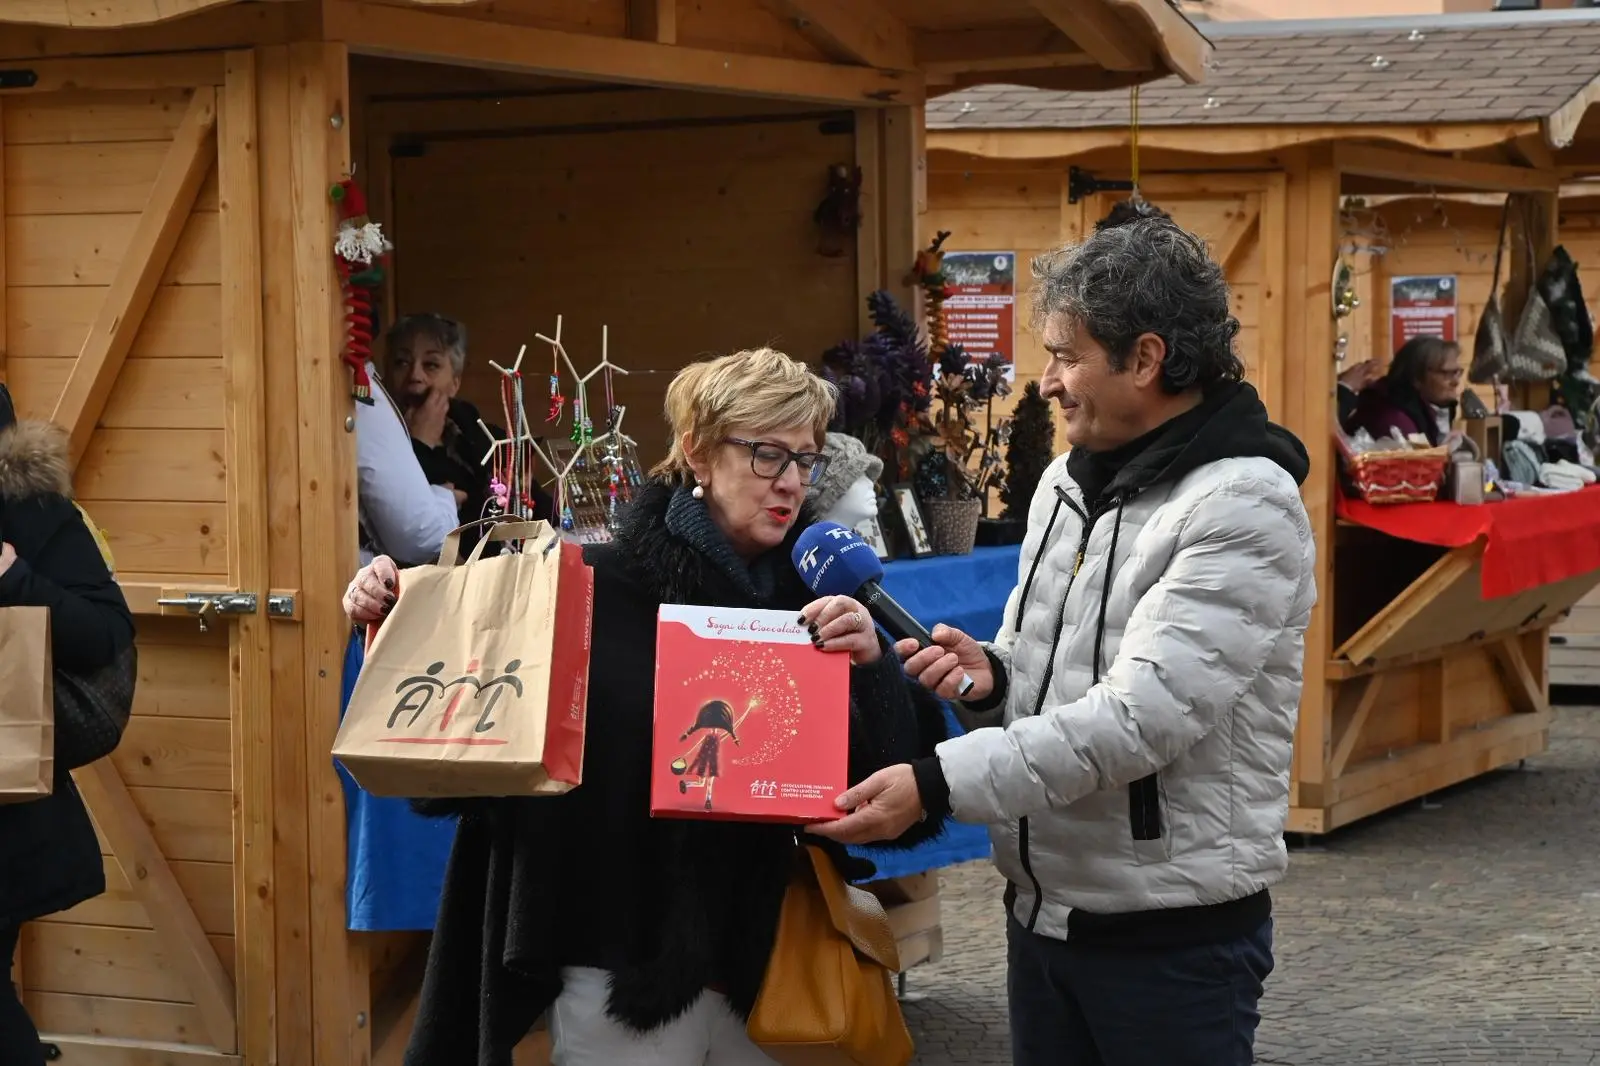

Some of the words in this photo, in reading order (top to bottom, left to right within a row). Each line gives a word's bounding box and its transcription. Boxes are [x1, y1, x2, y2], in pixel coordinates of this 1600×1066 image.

[811, 554, 834, 591] TELETUTTO
[706, 616, 735, 635] Sogni
[737, 619, 747, 631] di
[749, 619, 801, 634] Cioccolato
